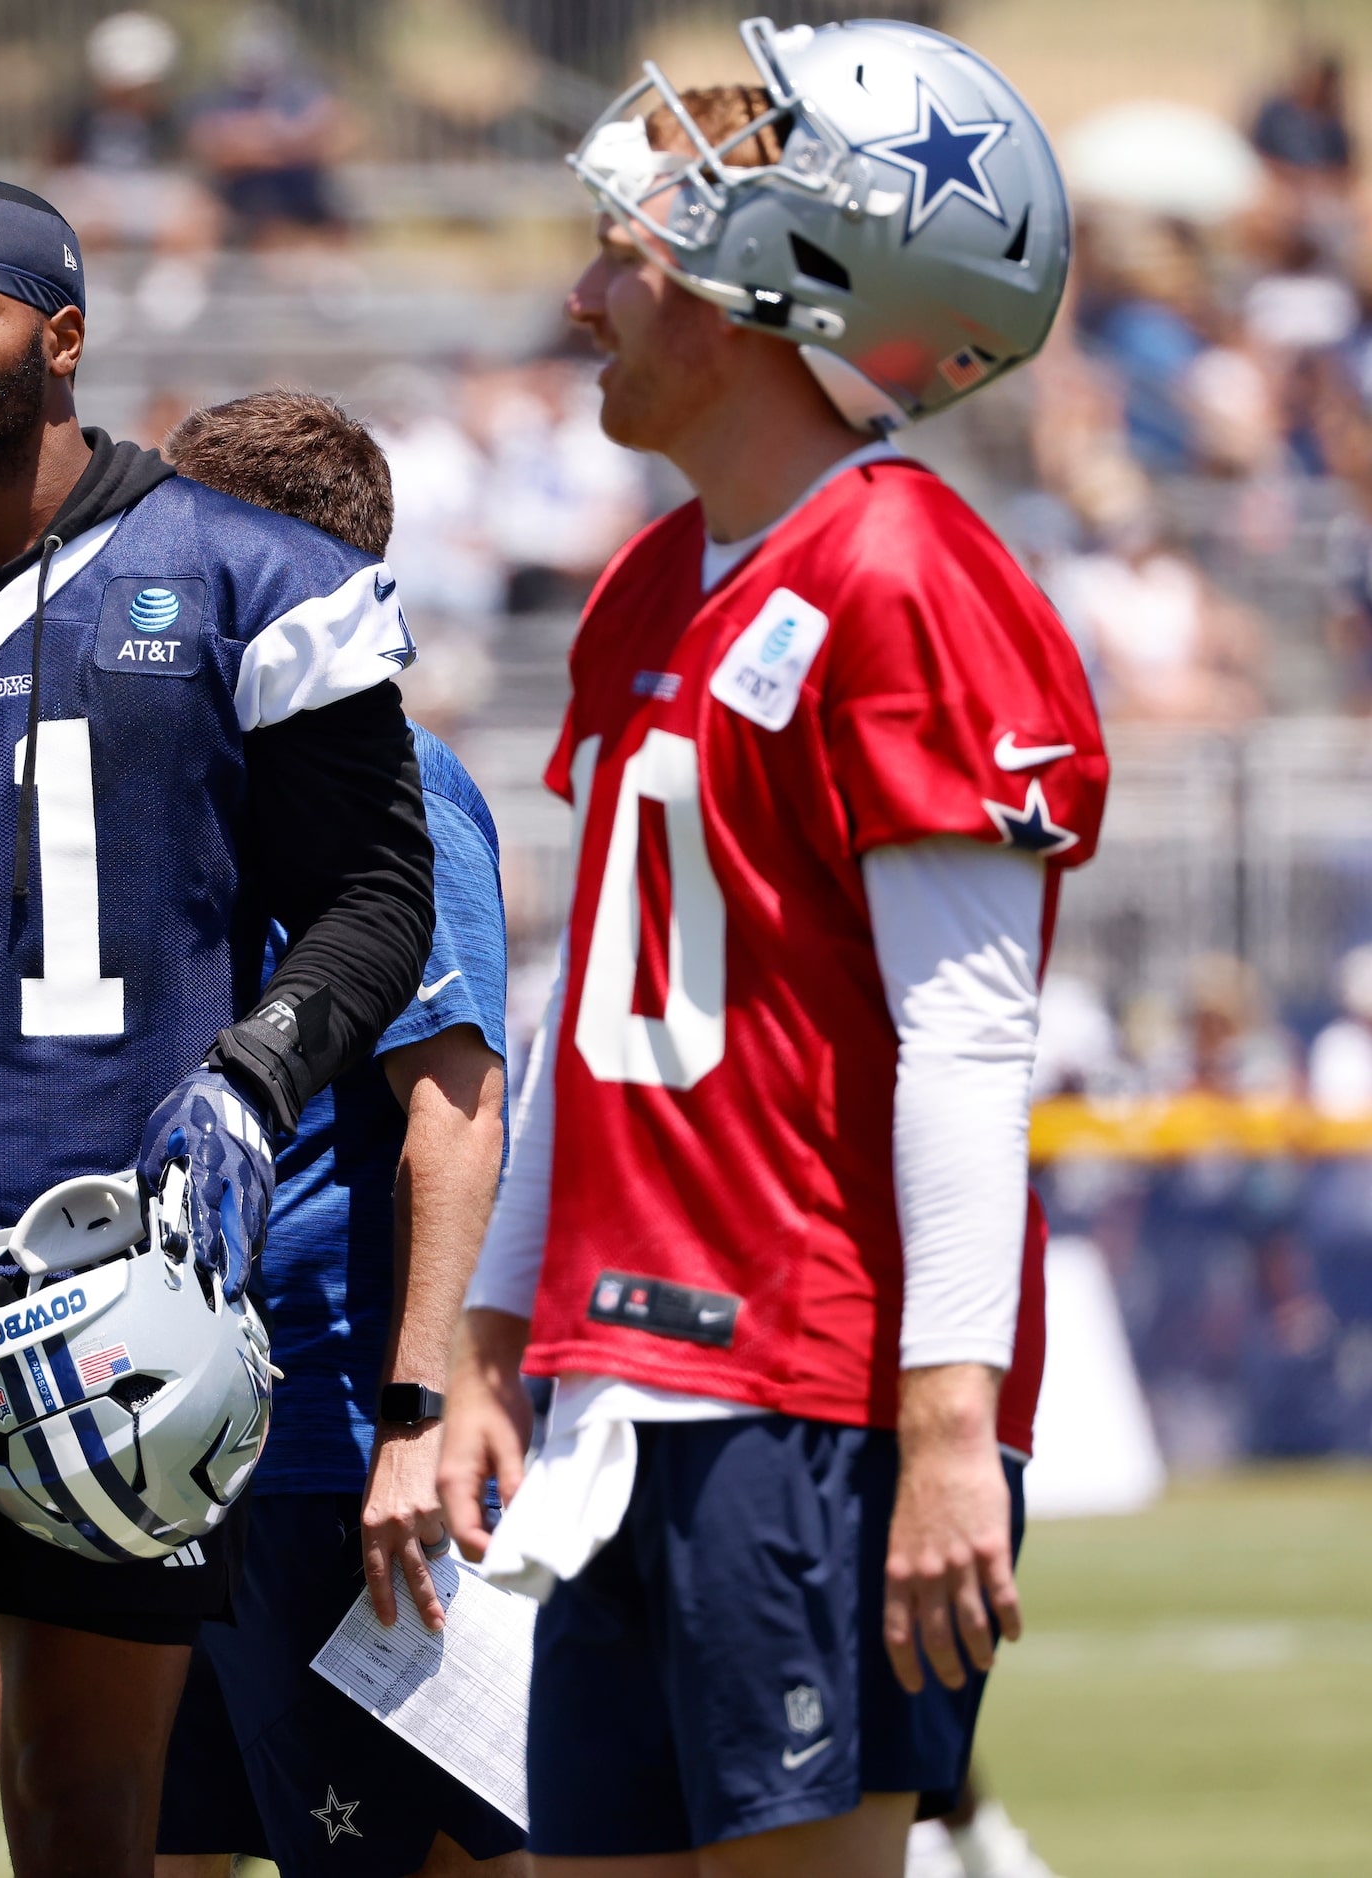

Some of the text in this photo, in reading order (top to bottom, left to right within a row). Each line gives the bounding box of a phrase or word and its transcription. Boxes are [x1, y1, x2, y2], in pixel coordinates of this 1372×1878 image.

[116, 639, 182, 663] AT&T
[569, 727, 727, 1092] 0
[30, 1360, 54, 1407] PARSONS
